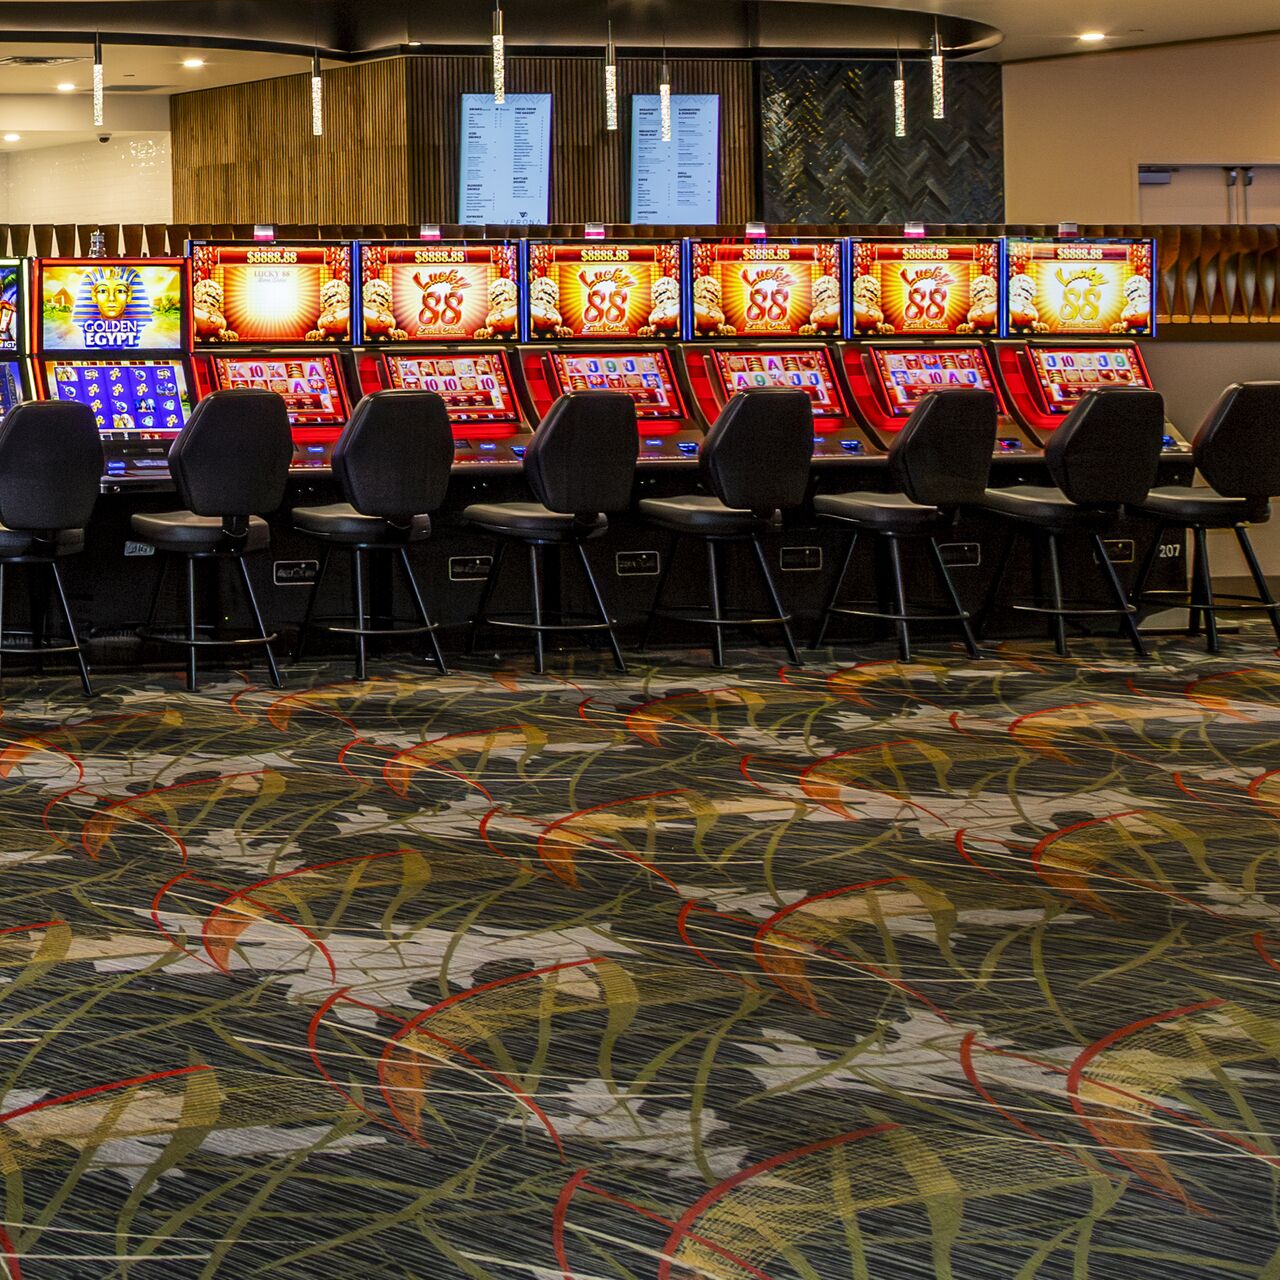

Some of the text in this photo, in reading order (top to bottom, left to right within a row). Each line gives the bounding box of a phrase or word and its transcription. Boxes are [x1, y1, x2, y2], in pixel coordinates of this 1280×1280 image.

[419, 291, 464, 325] 88
[583, 290, 628, 324] 88
[746, 288, 789, 320] 88
[905, 287, 947, 320] 88
[1060, 287, 1102, 320] 88
[84, 320, 138, 332] GOLDEN
[86, 332, 137, 345] EGYPT
[1061, 355, 1074, 367] 10
[249, 365, 263, 378] 10
[929, 372, 942, 384] 10
[424, 378, 495, 391] 10 10 10
[1159, 544, 1181, 558] 207
